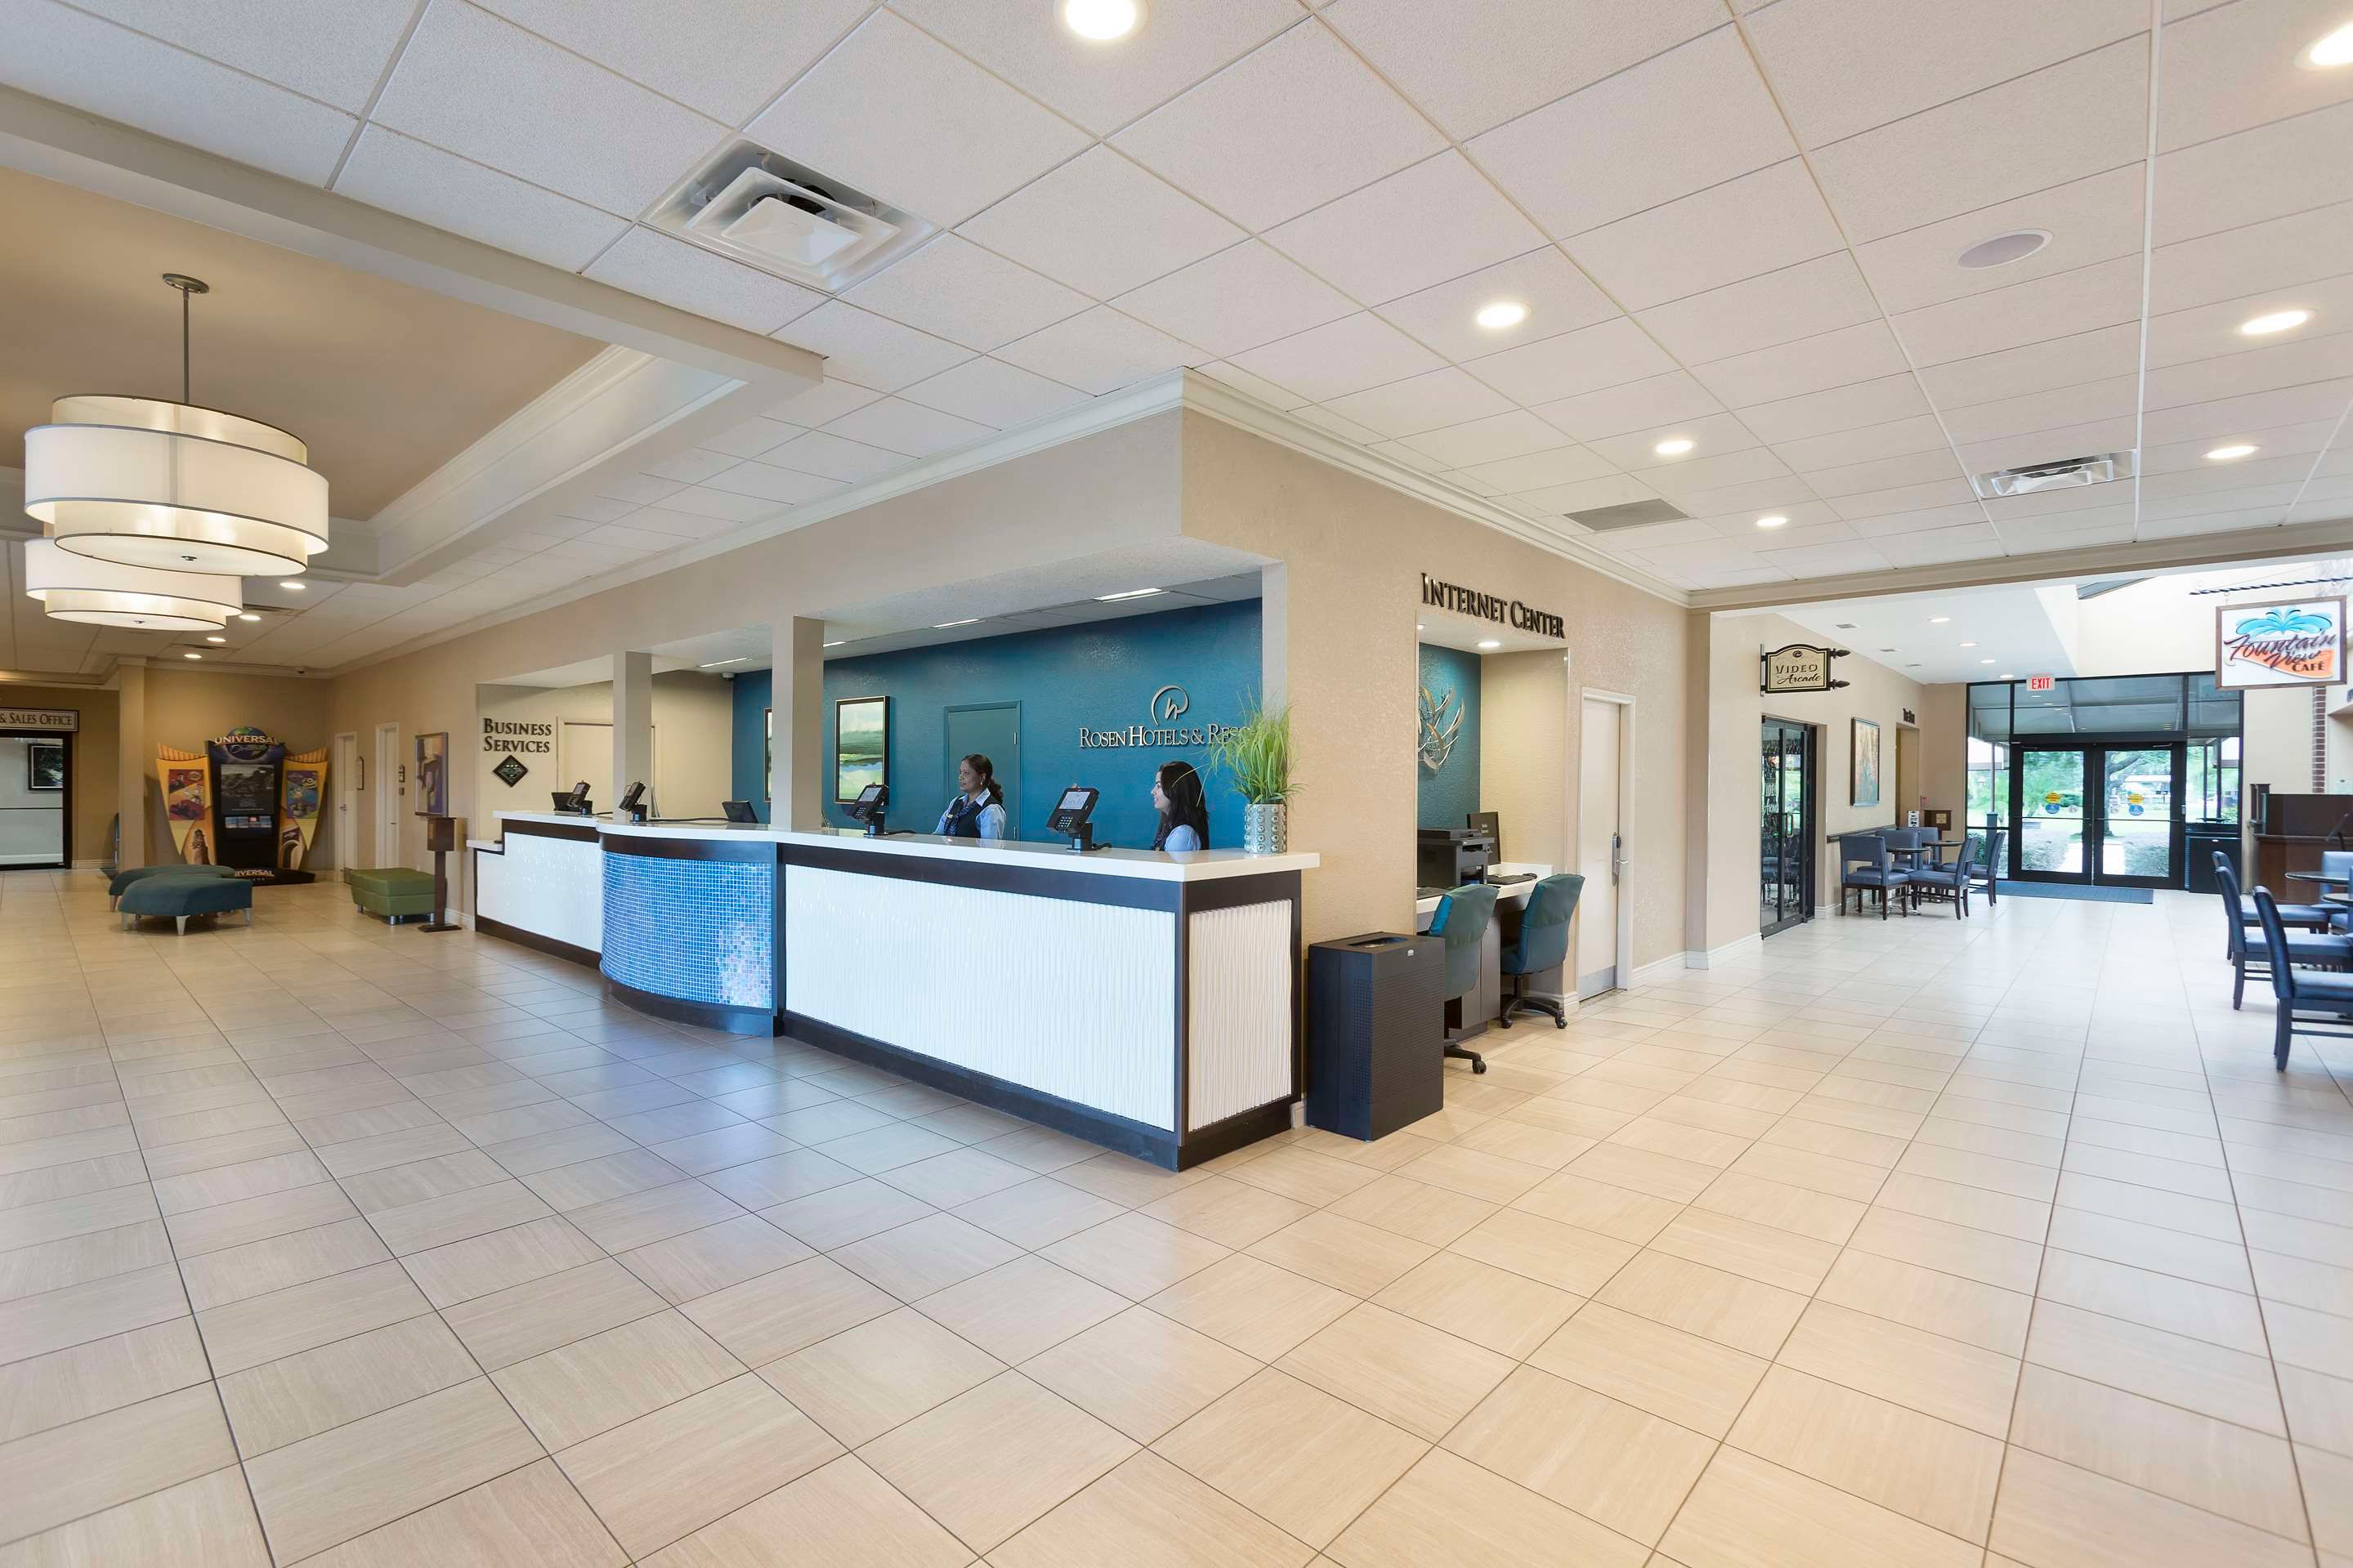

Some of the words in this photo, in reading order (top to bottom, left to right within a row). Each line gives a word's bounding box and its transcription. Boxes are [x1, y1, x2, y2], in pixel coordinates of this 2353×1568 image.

[1420, 572, 1507, 623] INTERNET
[1510, 601, 1566, 639] CENTER
[2223, 628, 2337, 661] Fountain
[2263, 650, 2321, 668] View
[2292, 660, 2325, 672] CAFÉ
[1775, 664, 1818, 674] VIDEO
[1777, 673, 1822, 685] Arcade
[2031, 677, 2051, 690] EXIT
[9, 712, 37, 725] SALES
[39, 713, 73, 726] OFFICE
[482, 717, 552, 736] BUSINESS
[214, 735, 277, 744] UNIVERSAL
[483, 736, 550, 753] SERVICES
[1079, 726, 1126, 748] ROSEN
[1129, 726, 1190, 747] HOTELS
[1191, 729, 1206, 745] &
